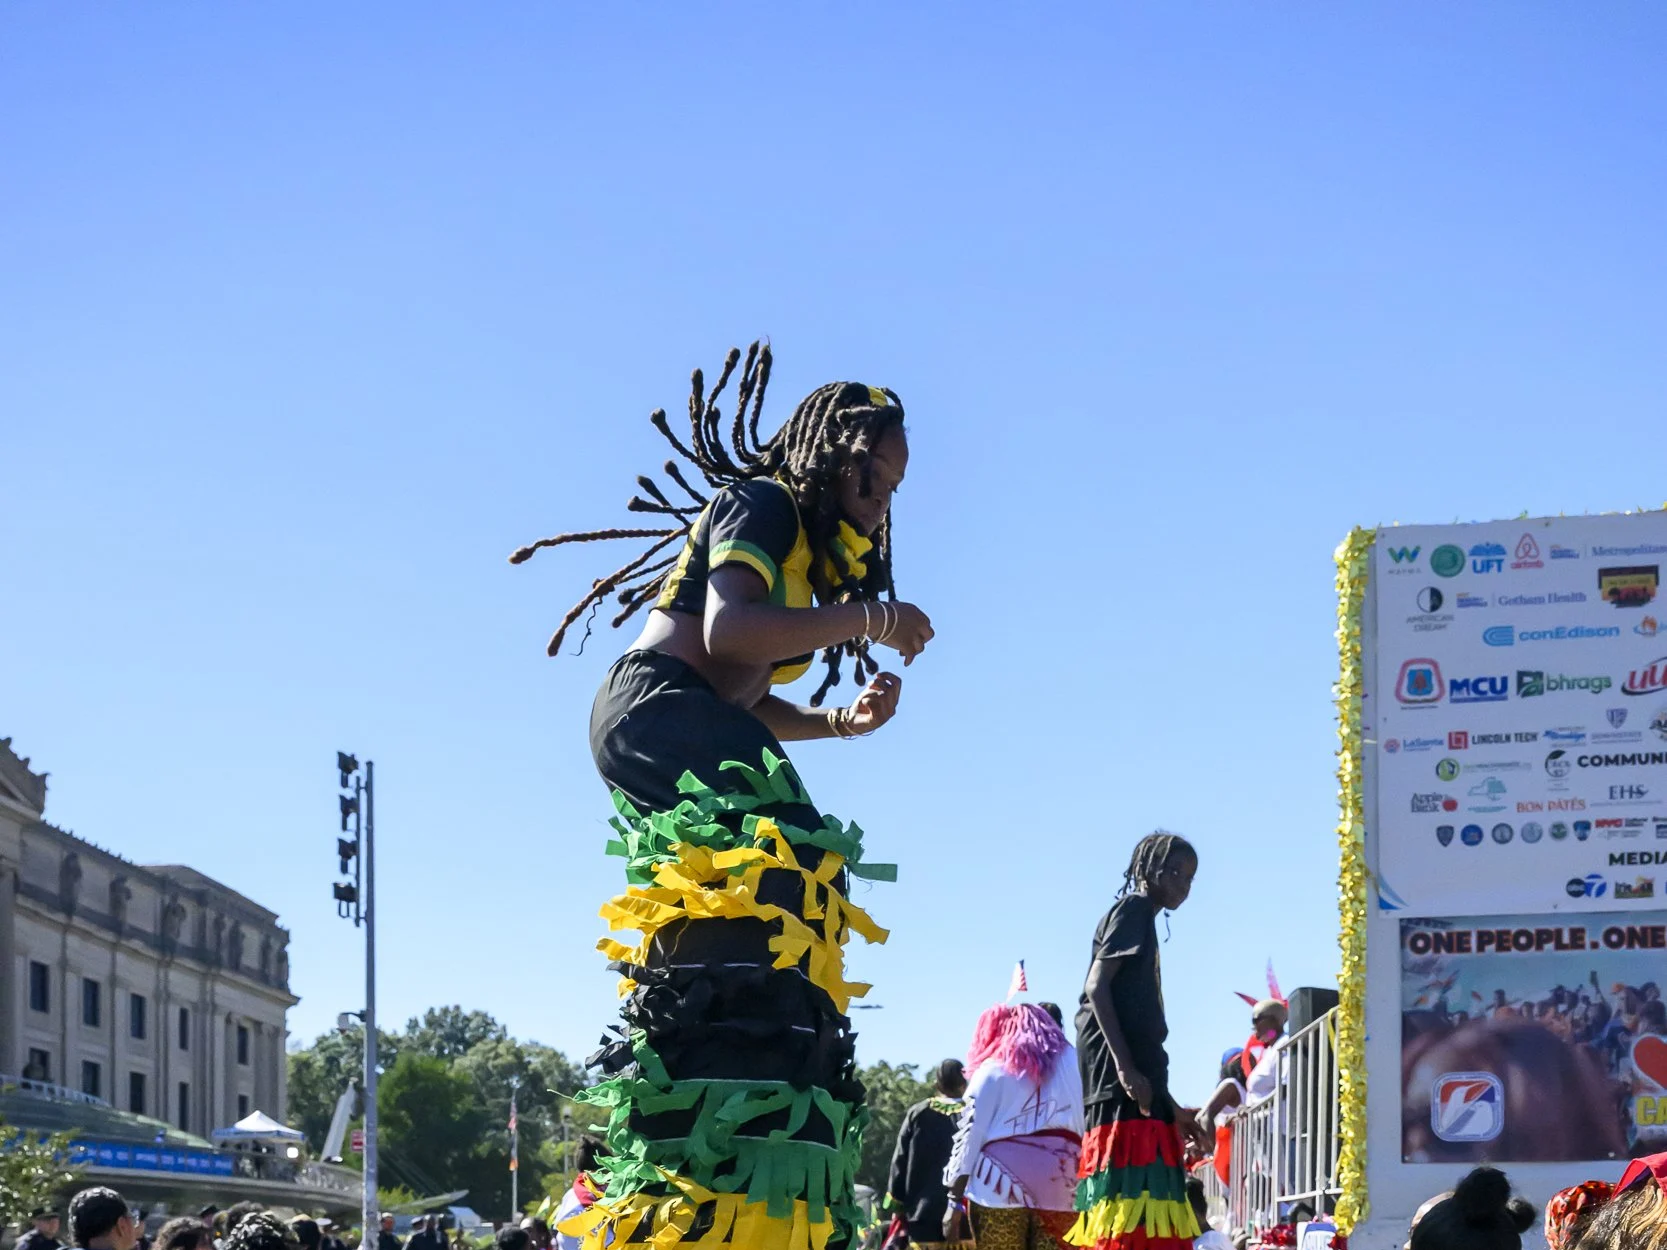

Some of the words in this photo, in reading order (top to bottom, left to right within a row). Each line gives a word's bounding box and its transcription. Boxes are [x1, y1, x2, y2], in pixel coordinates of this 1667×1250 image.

[1472, 559, 1505, 574] UFT
[1498, 594, 1546, 607] Gotham
[1547, 591, 1587, 605] Health
[1519, 626, 1620, 641] conEdison
[1450, 675, 1508, 697] MCU
[1546, 673, 1612, 694] bhrags
[1471, 732, 1511, 745] LINCOLN
[1513, 731, 1538, 743] TECH
[1608, 784, 1648, 800] EHS
[1516, 801, 1544, 813] BON
[1408, 930, 1472, 955] ONE
[1602, 925, 1667, 950] ONE
